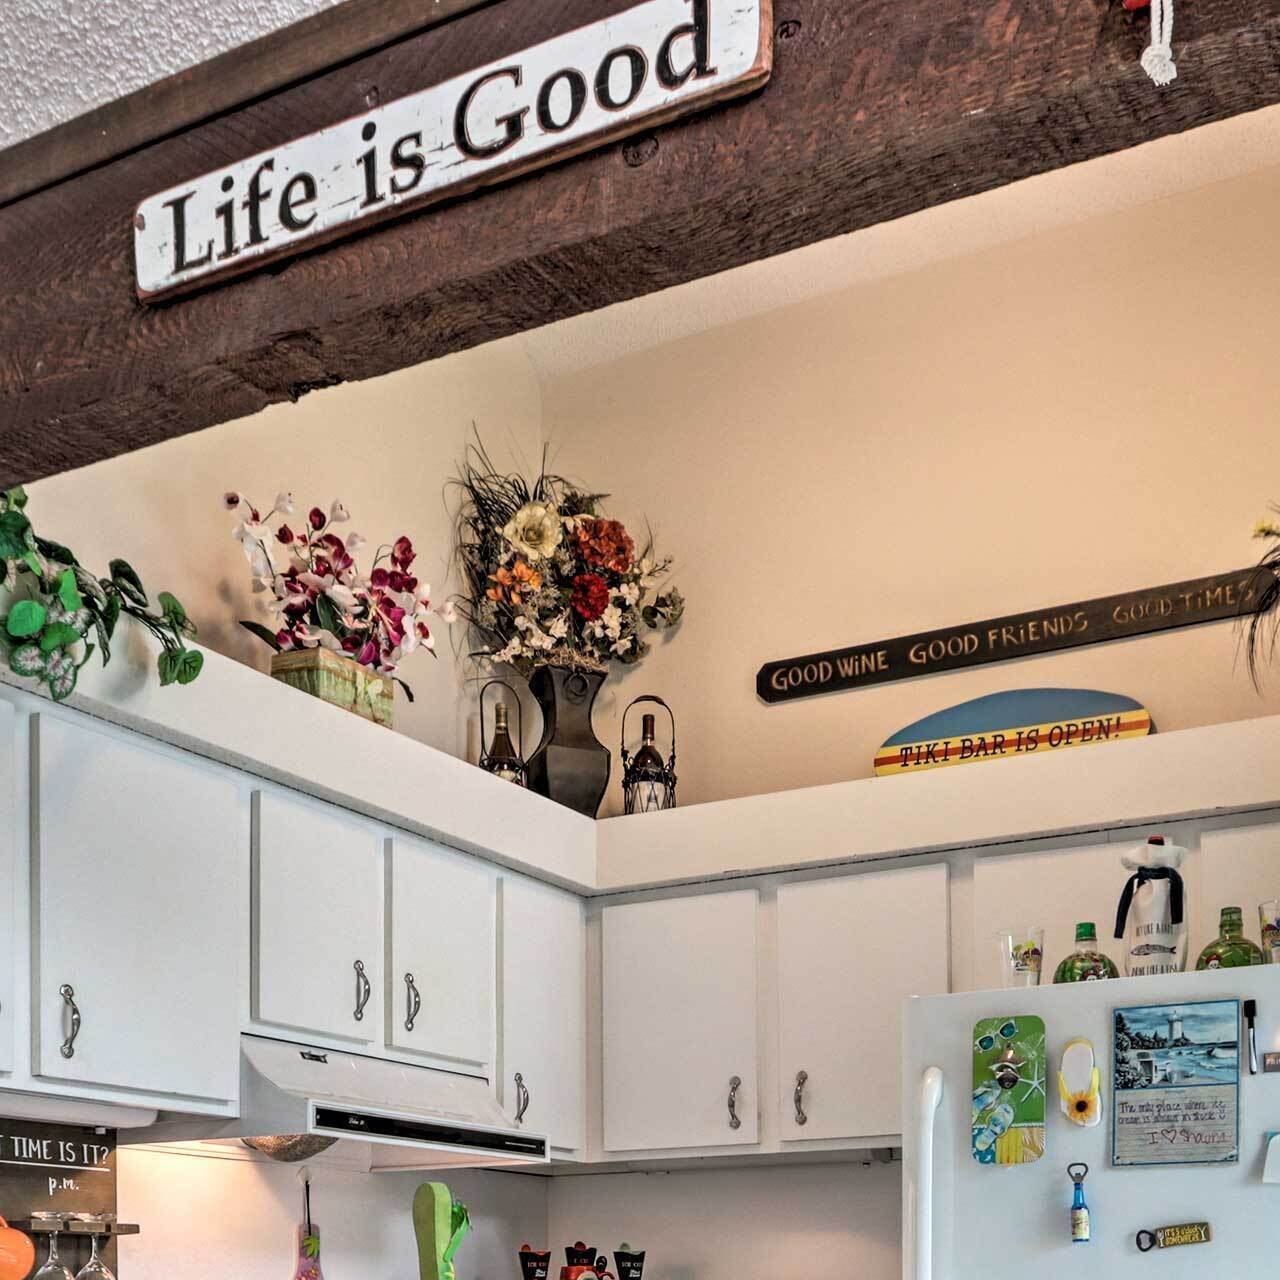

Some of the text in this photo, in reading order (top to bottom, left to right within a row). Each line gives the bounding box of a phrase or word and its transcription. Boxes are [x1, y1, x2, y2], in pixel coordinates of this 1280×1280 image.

[161, 0, 720, 276] Life is Good
[771, 660, 833, 691] GOOD
[908, 633, 979, 664] GOOD
[1112, 598, 1174, 625] GOOD
[899, 716, 1122, 768] TIKI BAR IS OPEN!
[10, 1135, 53, 1160] TIME
[58, 1140, 76, 1163] IS
[82, 1143, 109, 1165] IT?
[48, 1176, 81, 1197] p.m.
